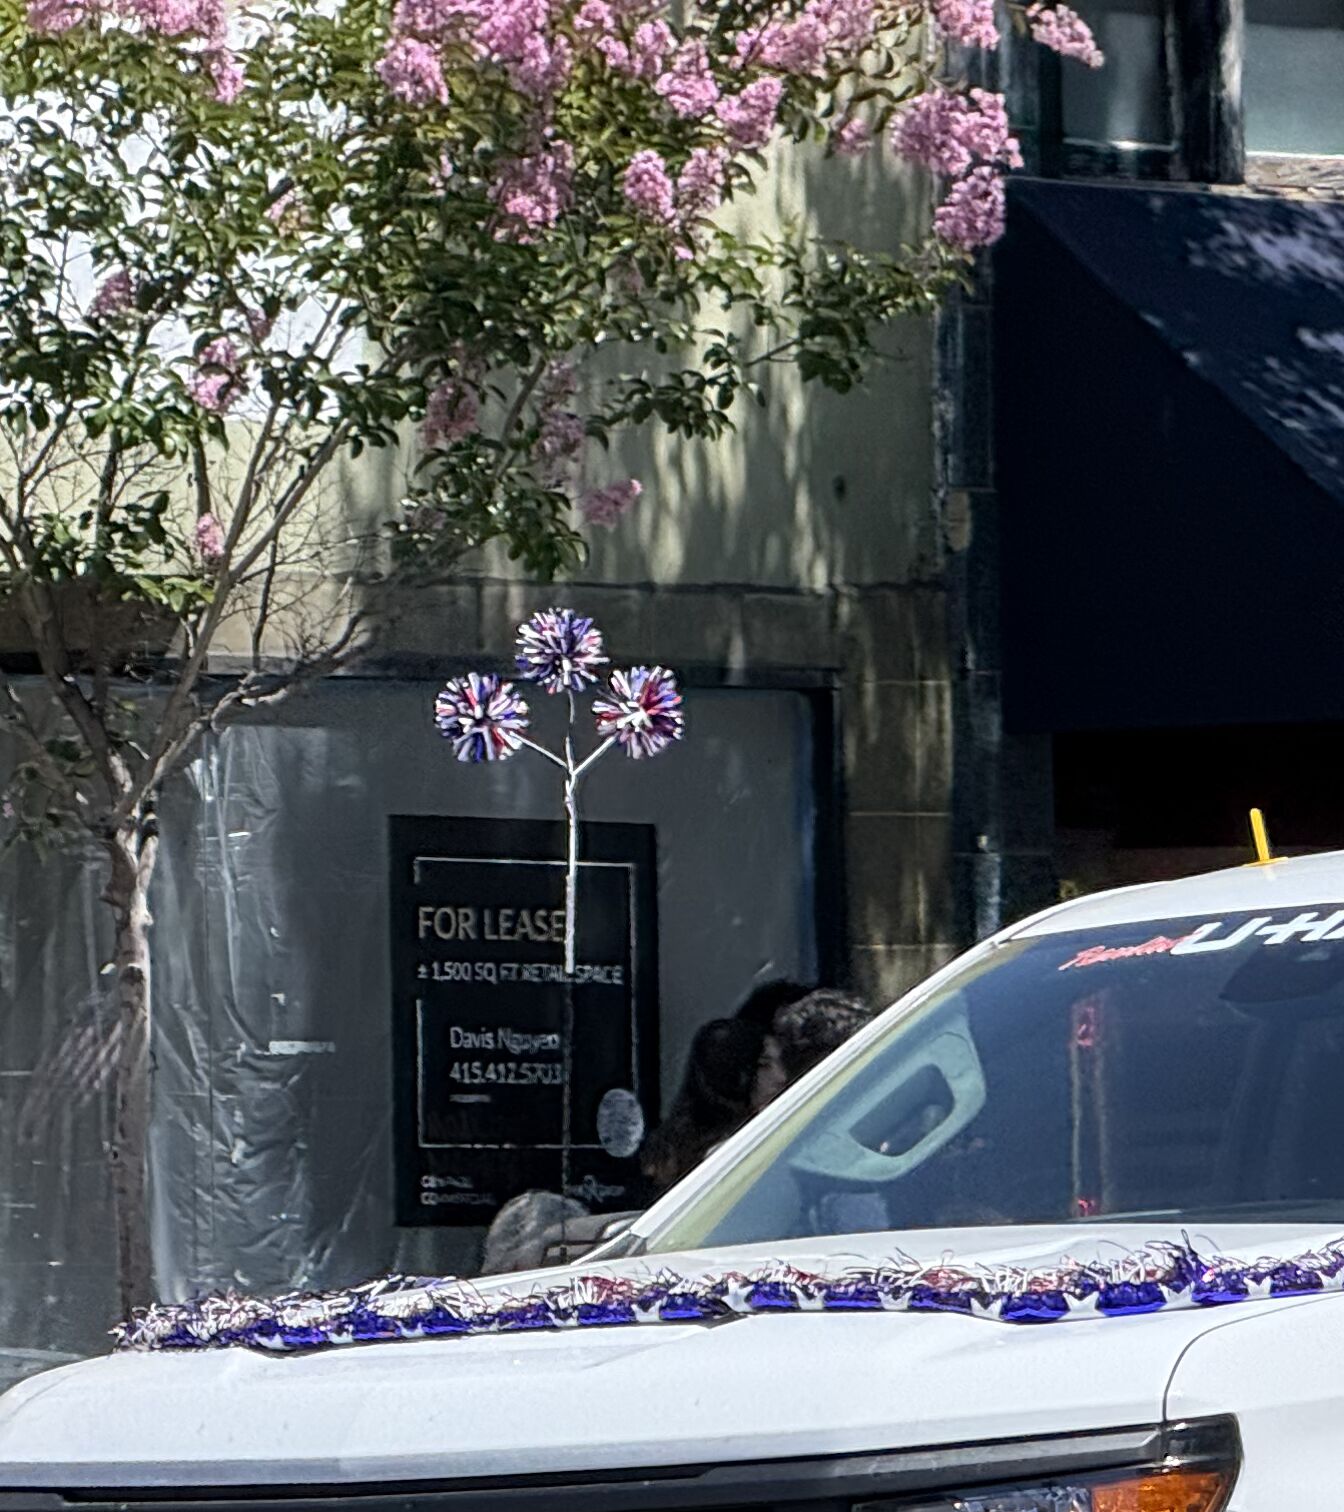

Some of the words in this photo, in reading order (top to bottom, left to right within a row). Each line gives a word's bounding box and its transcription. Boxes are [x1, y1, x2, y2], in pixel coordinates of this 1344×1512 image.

[417, 907, 476, 940] FOR
[483, 908, 566, 942] LEASE
[474, 962, 498, 984] SQ
[450, 1027, 495, 1049] Davis
